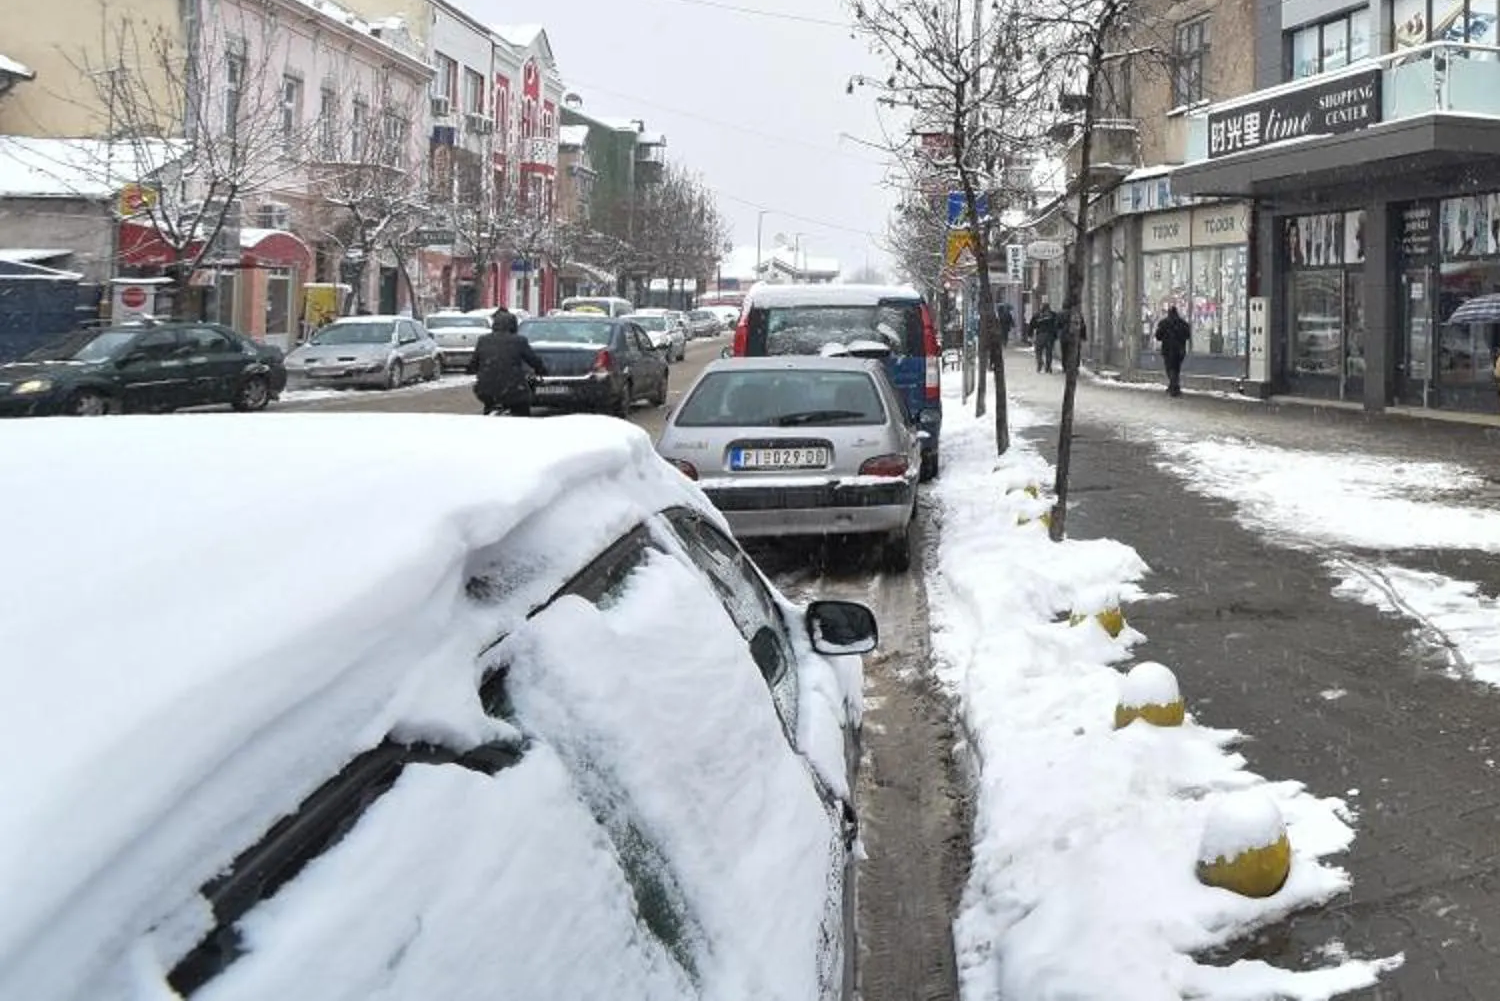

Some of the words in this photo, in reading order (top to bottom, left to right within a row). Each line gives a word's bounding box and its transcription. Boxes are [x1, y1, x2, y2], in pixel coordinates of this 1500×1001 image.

[1318, 84, 1373, 110] SHOPPING
[1264, 107, 1314, 142] time
[1325, 104, 1369, 126] CENTER
[1211, 111, 1261, 153] 时光里
